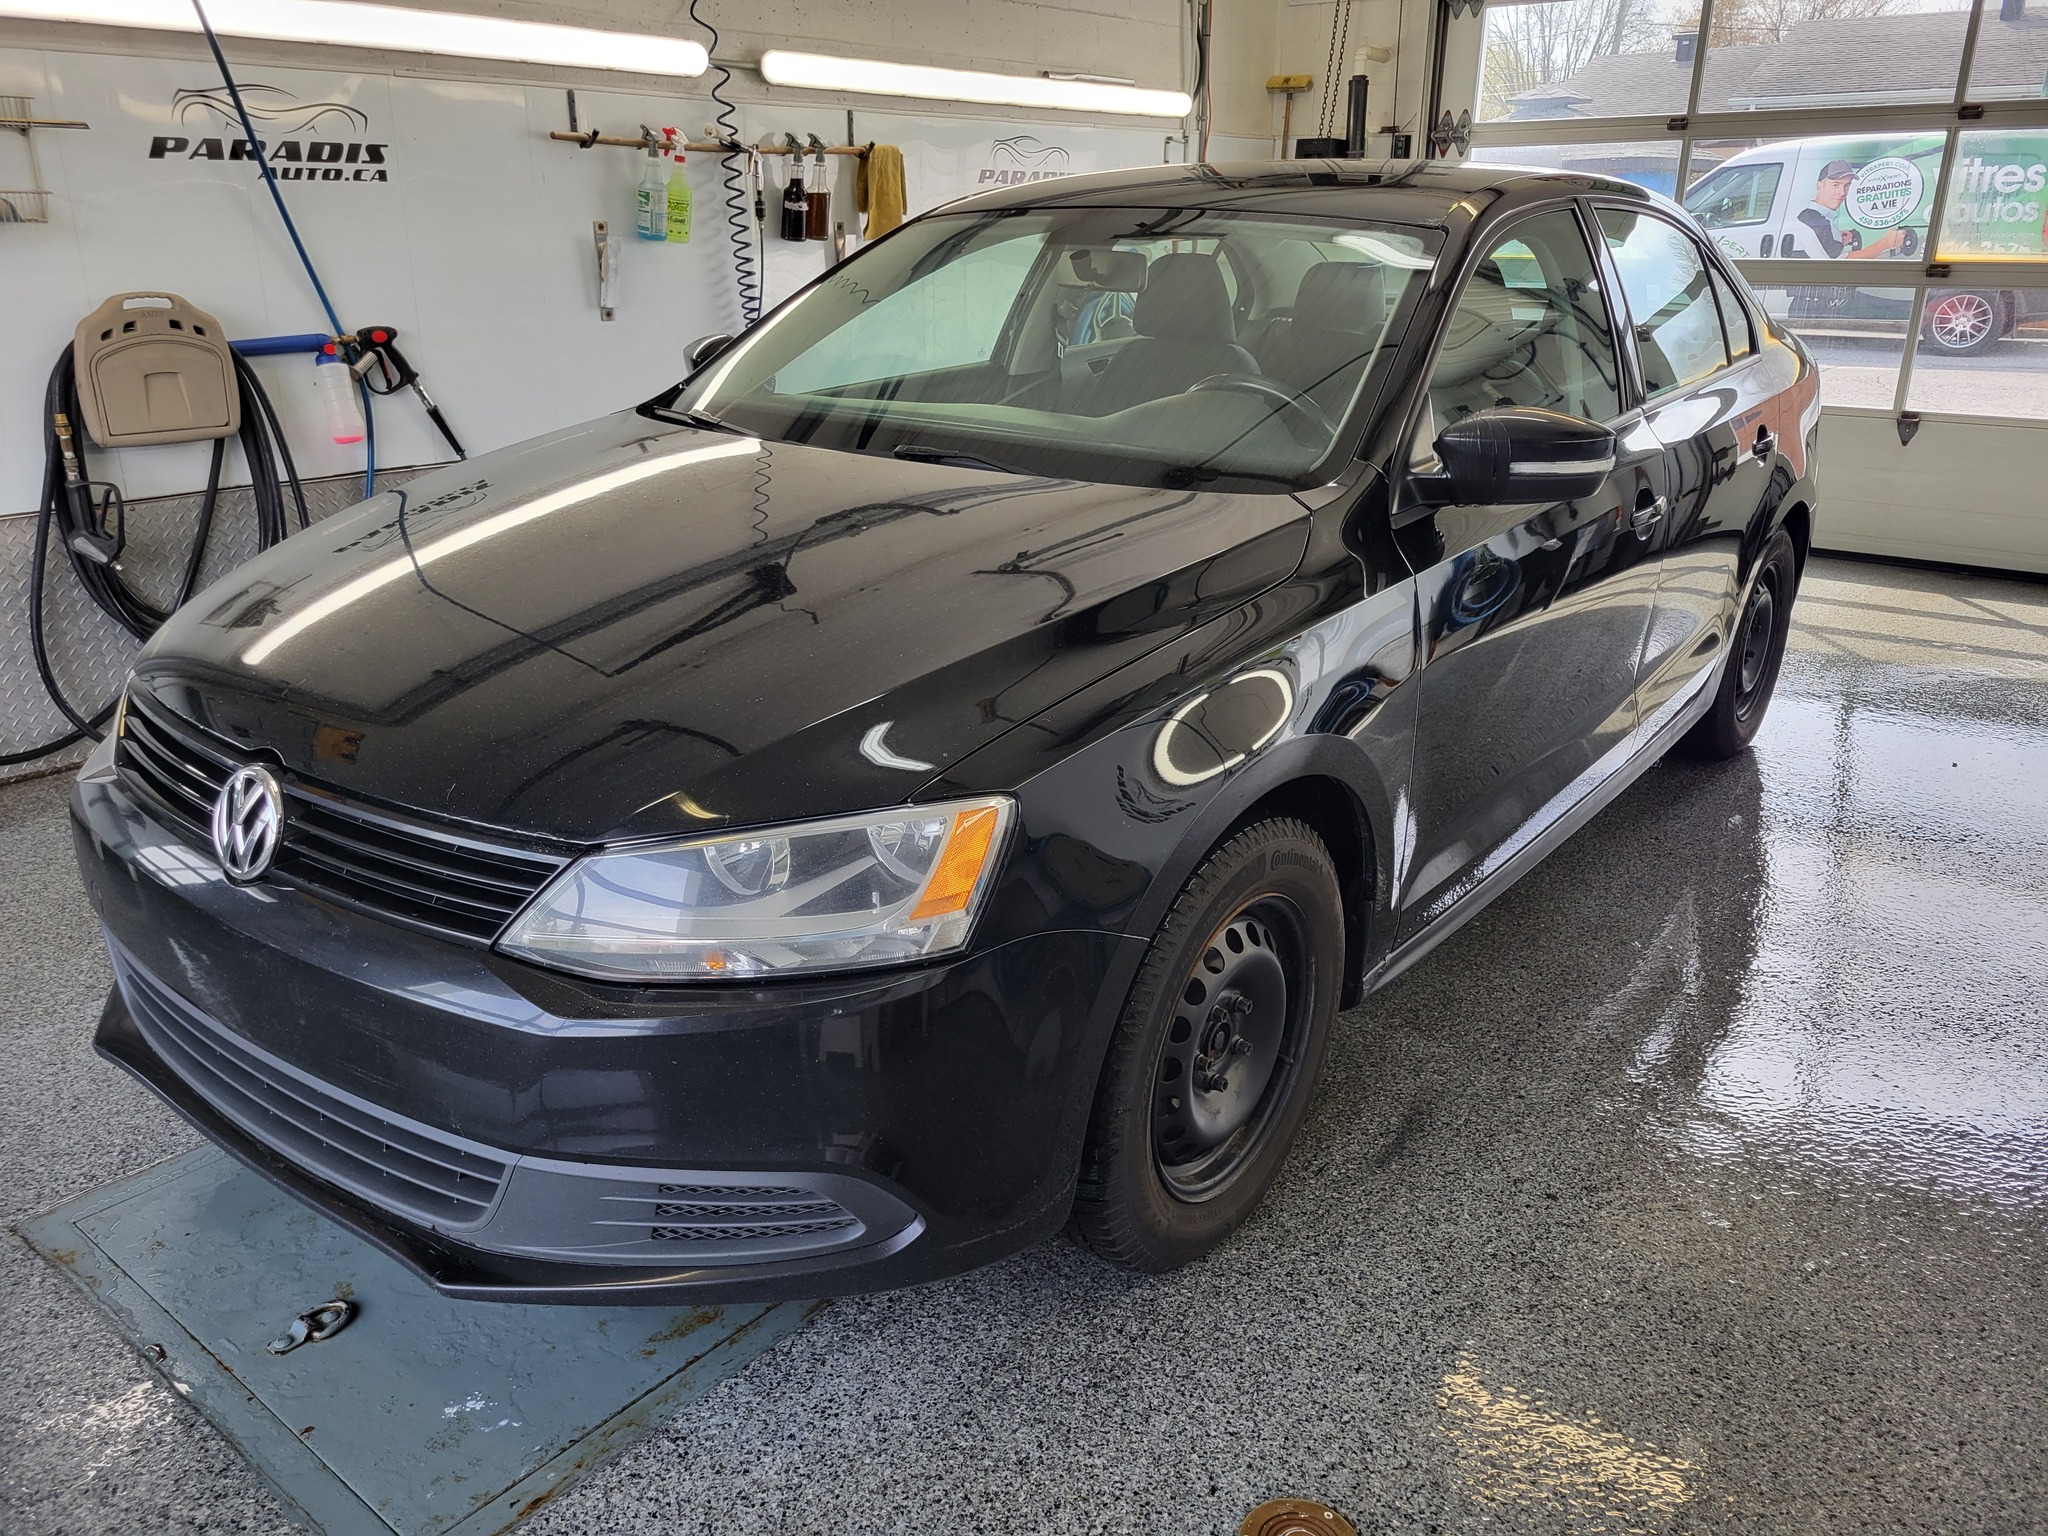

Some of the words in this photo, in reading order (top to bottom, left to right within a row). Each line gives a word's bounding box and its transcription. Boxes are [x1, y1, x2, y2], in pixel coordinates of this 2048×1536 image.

[149, 136, 389, 165] PARADIS
[257, 166, 388, 183] AUTO.CA
[1856, 187, 1912, 204] GRATUITES
[1881, 199, 1898, 209] VIE
[1859, 216, 1873, 225] 450
[1874, 209, 1909, 226] 536-3575
[1270, 848, 1320, 873] Continental
